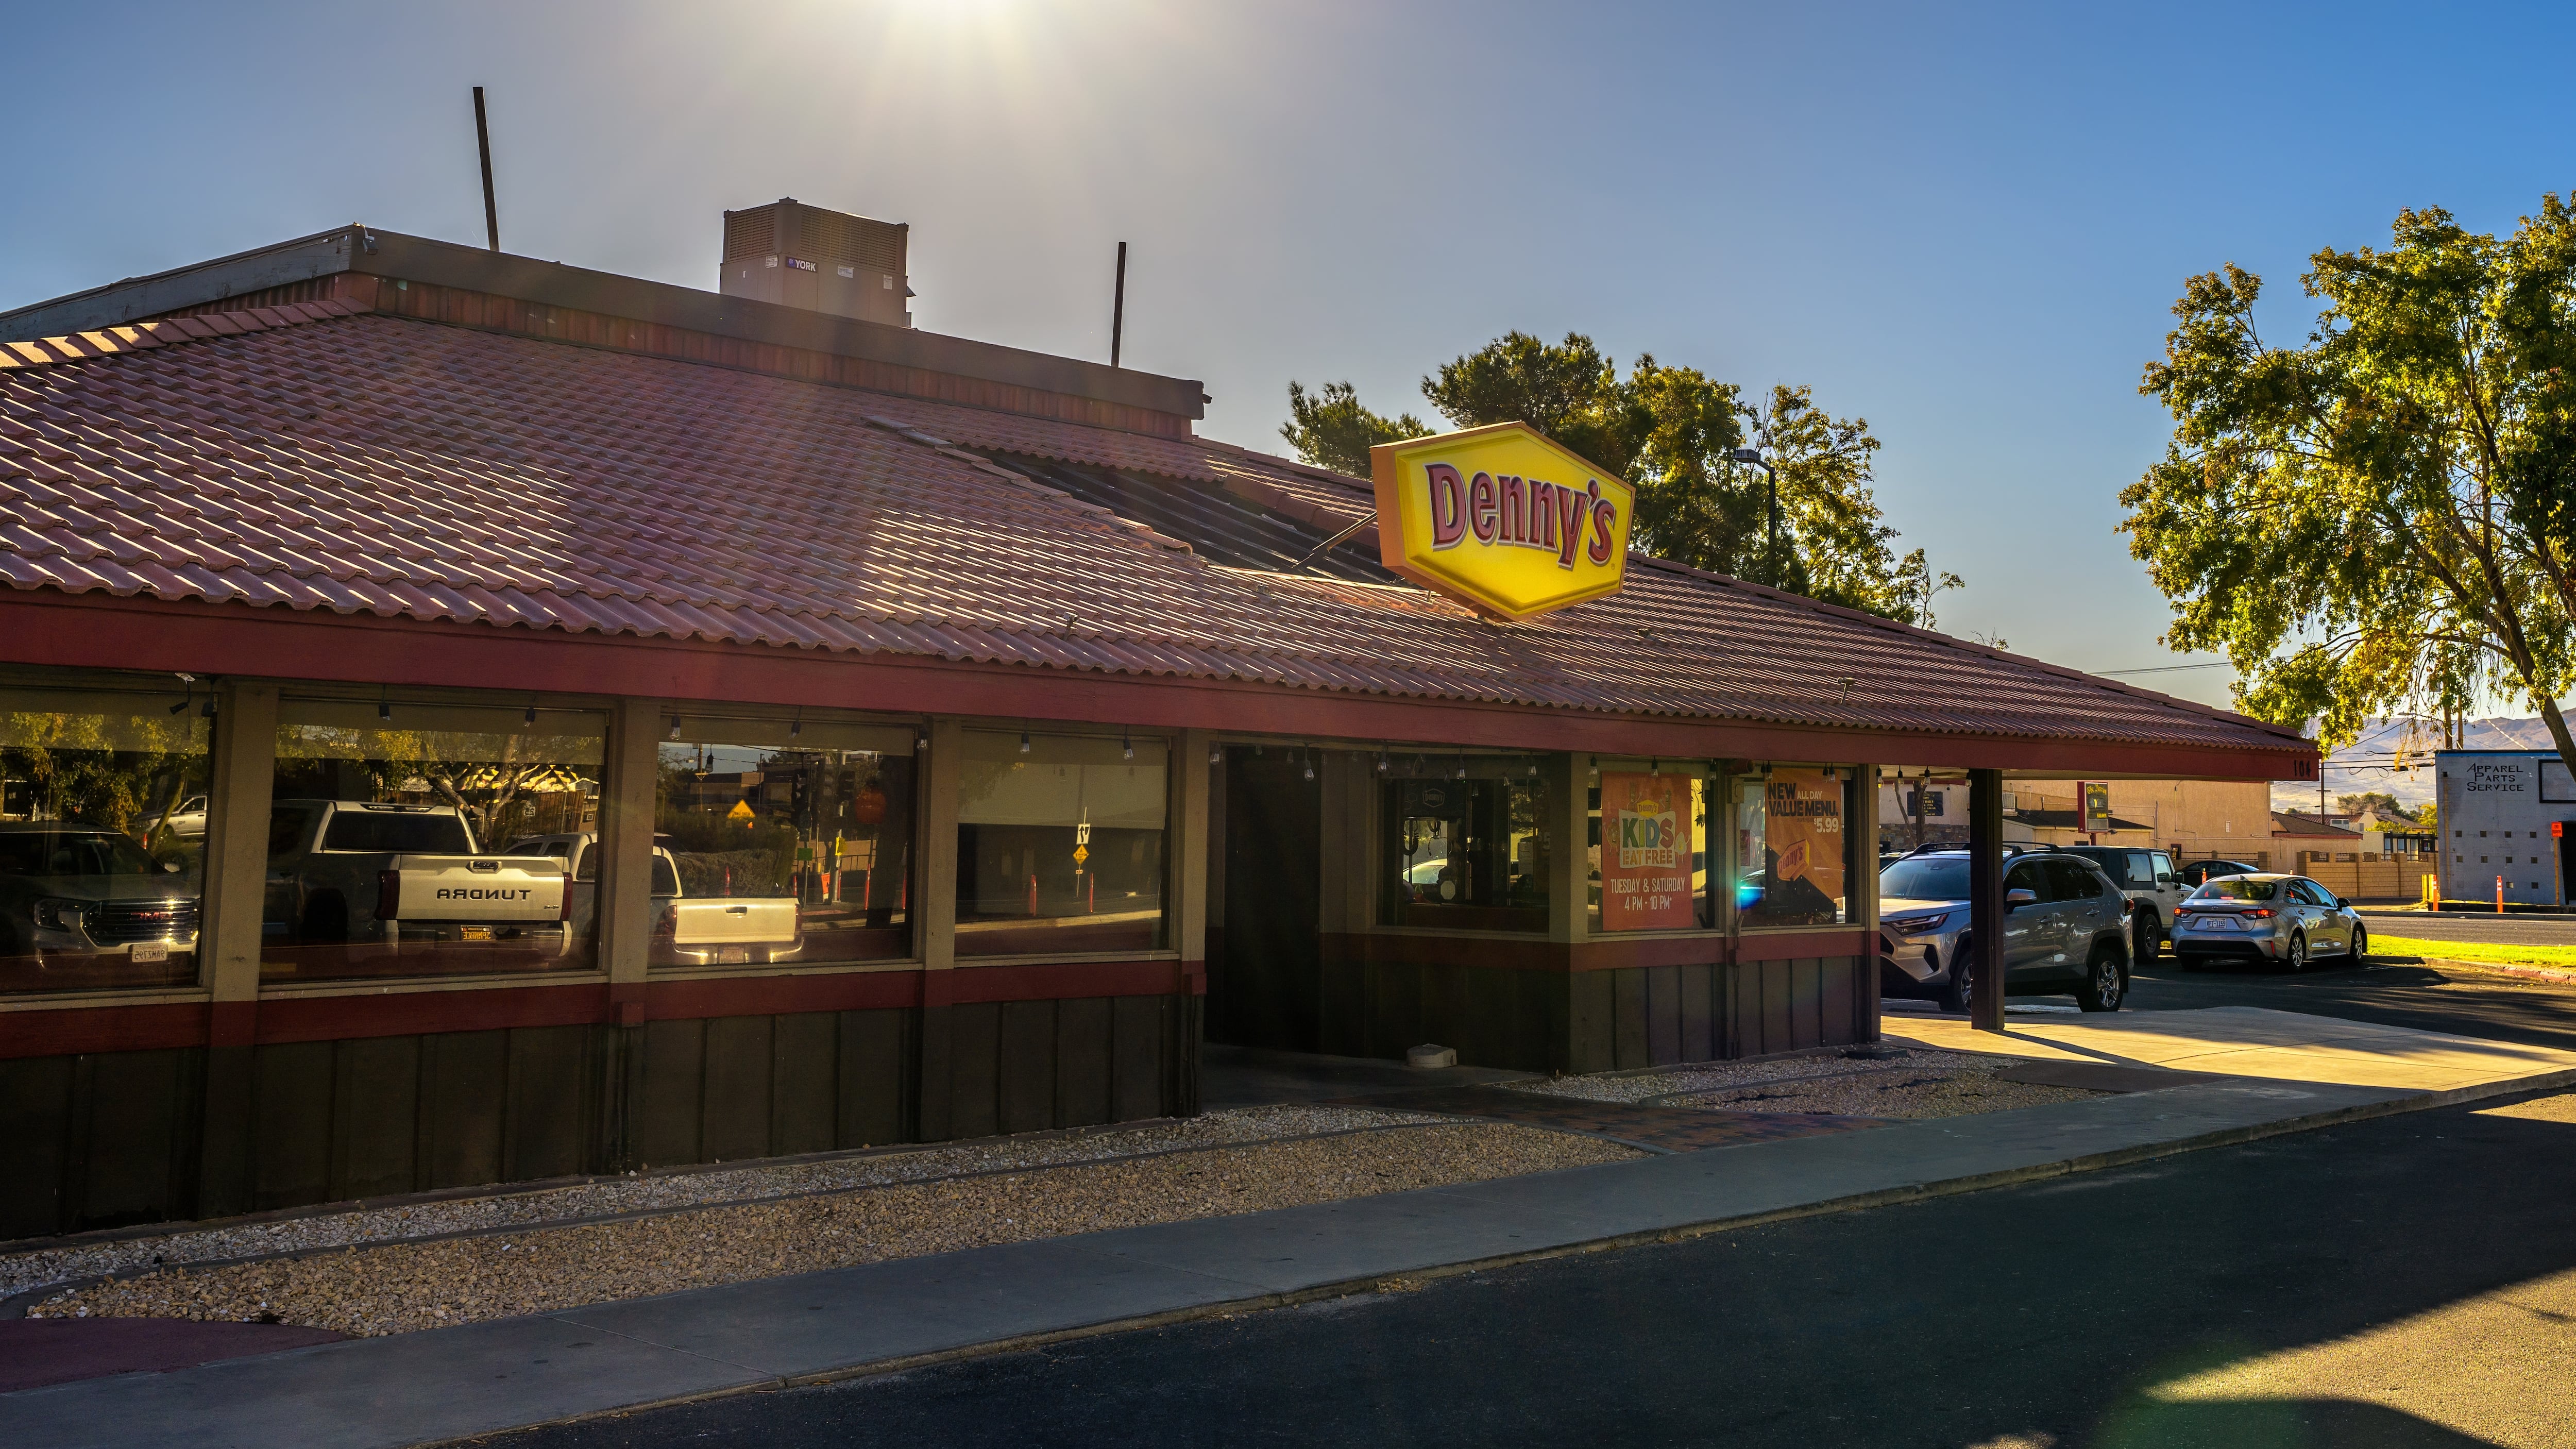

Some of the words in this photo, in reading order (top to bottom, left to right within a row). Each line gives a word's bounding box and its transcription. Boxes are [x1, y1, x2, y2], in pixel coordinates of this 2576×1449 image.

[795, 260, 816, 272] YORK
[1422, 462, 1616, 570] Denny's
[2294, 760, 2311, 777] 104
[2467, 763, 2523, 772] APPAREL
[2475, 772, 2515, 782] PARTS
[1768, 783, 1797, 800] NEW
[1797, 791, 1809, 800] ALL
[1810, 791, 1822, 800] DAY
[2467, 782, 2524, 791] SERVICE
[1638, 804, 1657, 813] Denny's
[1769, 800, 1803, 817] VALUE
[1805, 800, 1839, 817] MENU.
[1622, 817, 1674, 849] KIDS
[1814, 817, 1839, 833] $5.99
[1622, 850, 1643, 865] EAT
[1645, 849, 1673, 865] FREE
[1611, 878, 1640, 894] TUESDAY
[1643, 878, 1649, 893] &
[1652, 877, 1686, 892] SATURDAY
[1624, 896, 1630, 911] 4
[1632, 896, 1642, 911] PM
[1650, 895, 1657, 910] 10
